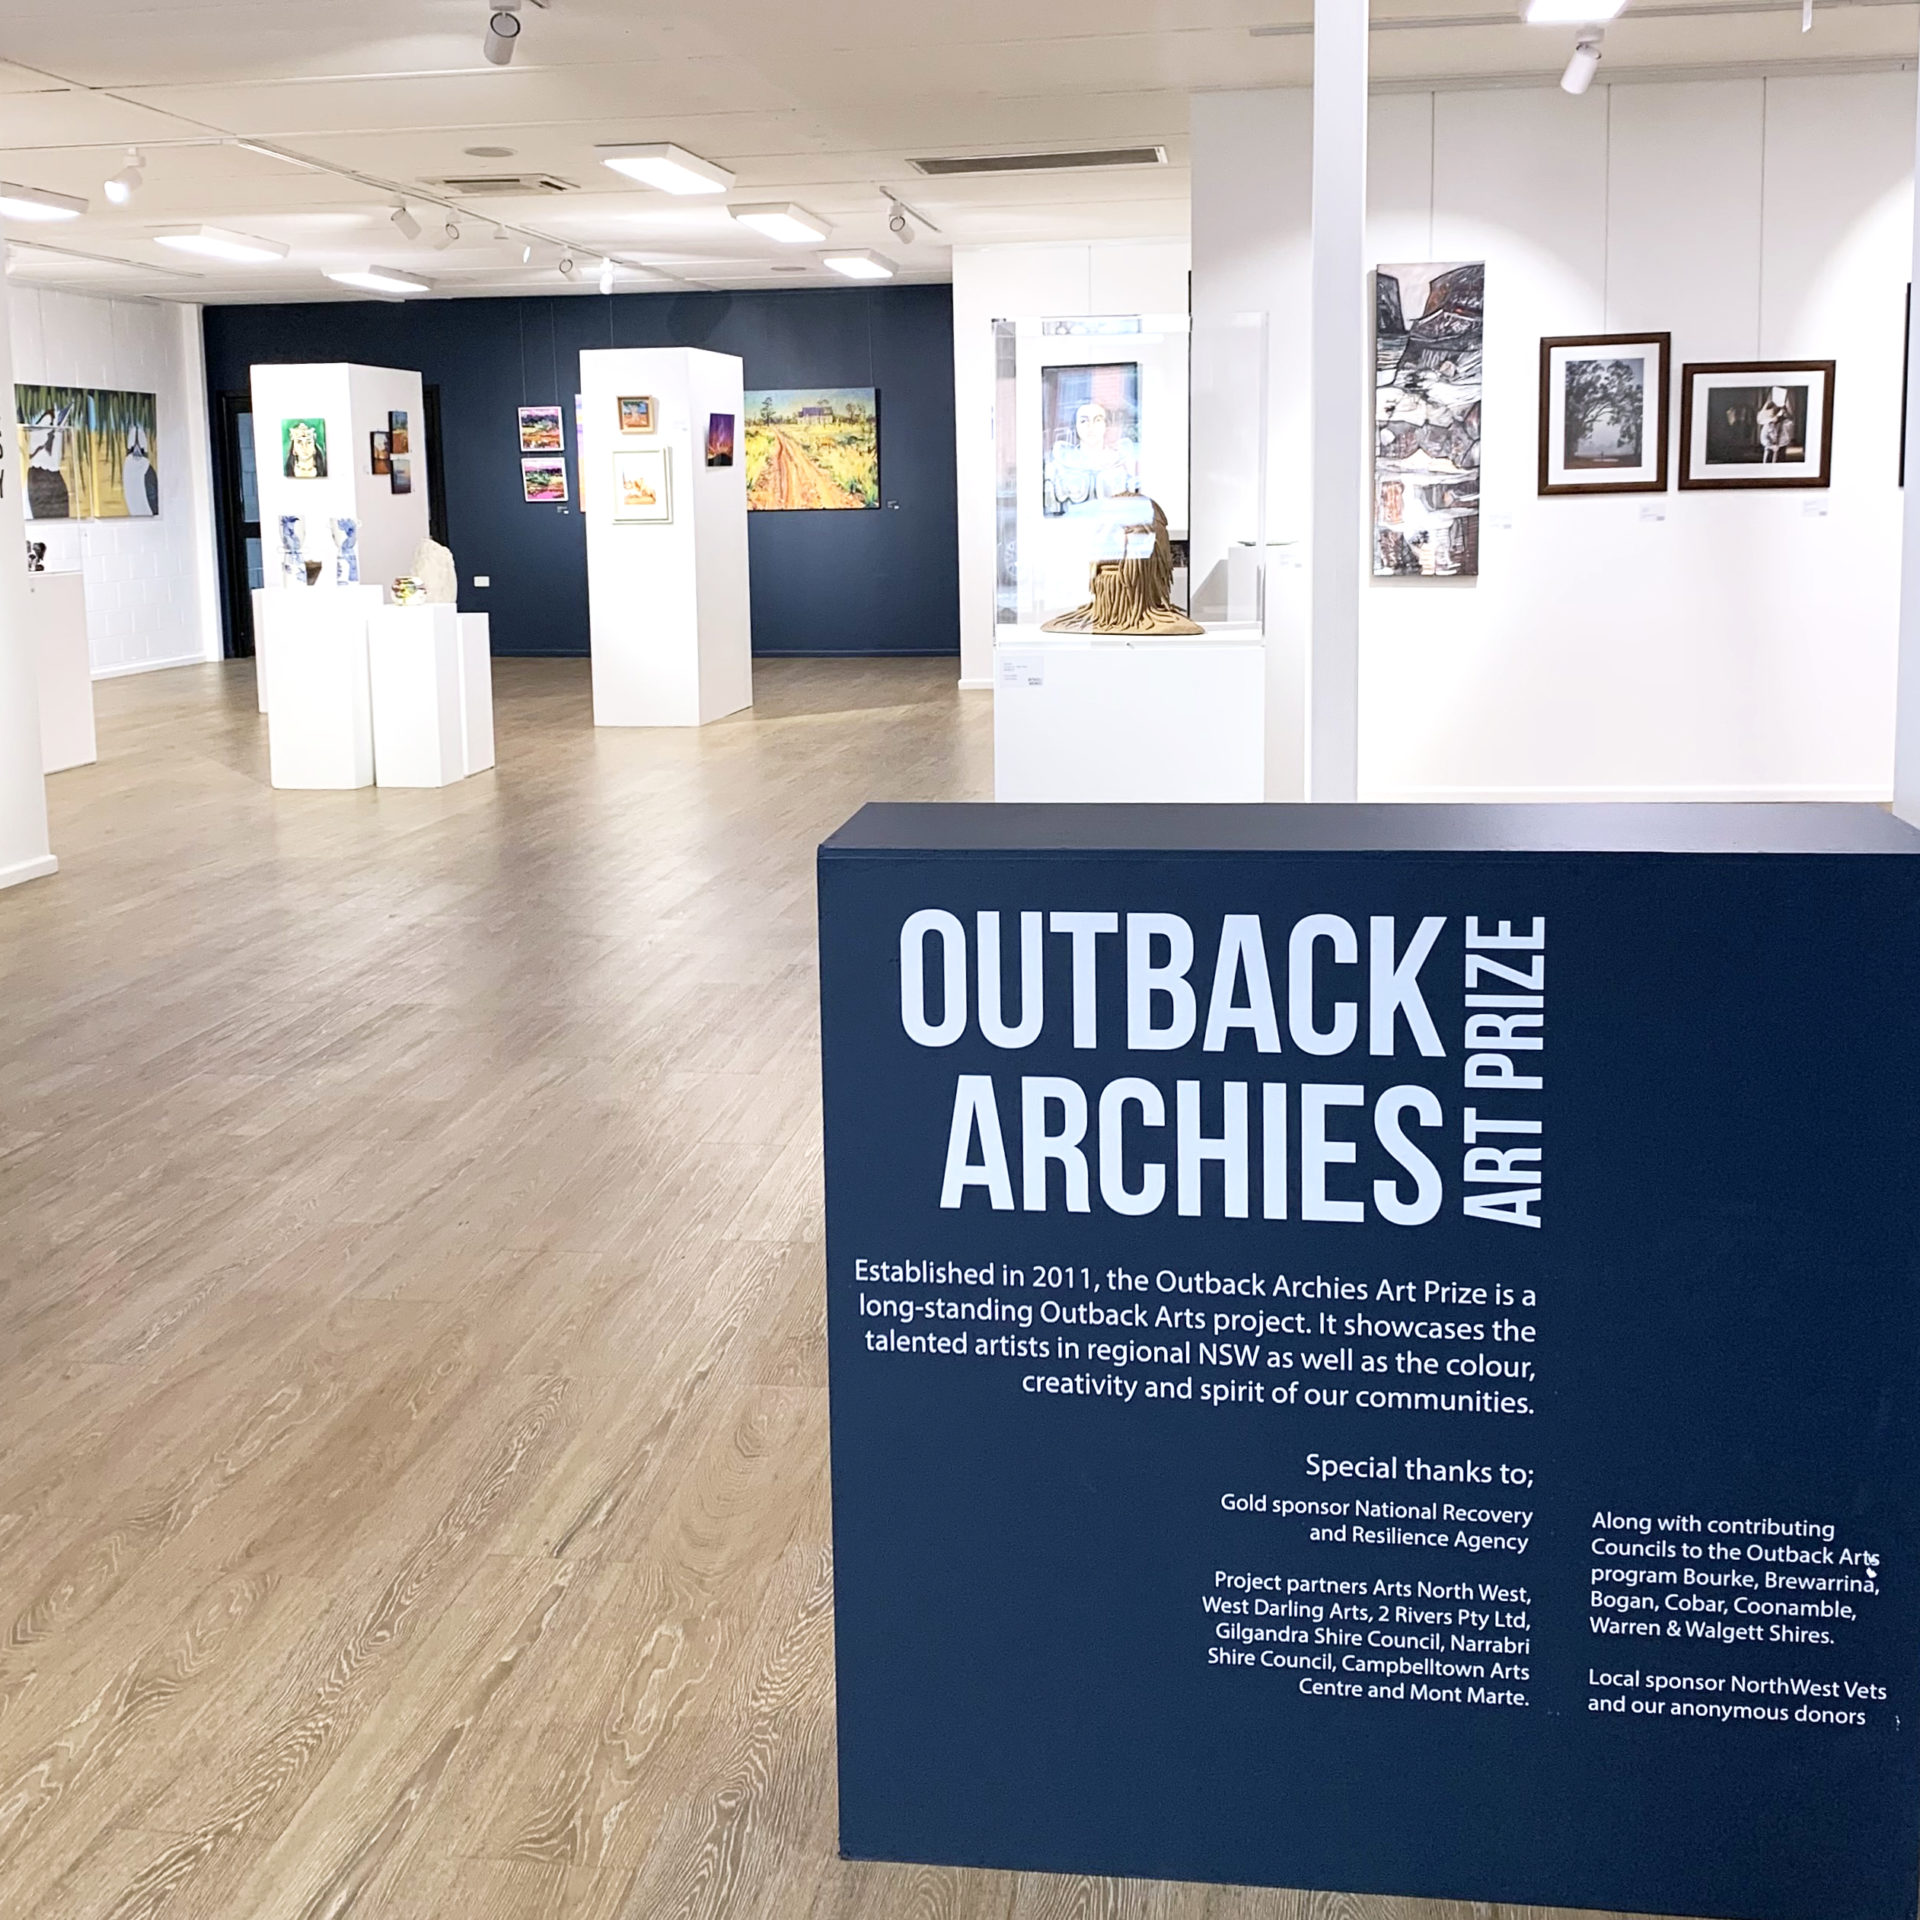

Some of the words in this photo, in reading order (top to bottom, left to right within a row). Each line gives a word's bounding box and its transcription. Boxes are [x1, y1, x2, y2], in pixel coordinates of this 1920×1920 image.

[899, 908, 1448, 1058] OUTBACK
[1463, 914, 1546, 1090] PRIZE
[939, 1074, 1443, 1226] ARCHIES
[1463, 1106, 1543, 1229] ART
[855, 1258, 995, 1286] Established
[1002, 1263, 1025, 1287] in
[1032, 1265, 1100, 1293] 2011,
[1106, 1266, 1149, 1292] the
[1155, 1269, 1267, 1297] Outback
[1272, 1274, 1369, 1301] Archies
[1375, 1278, 1417, 1303] Art
[1424, 1280, 1488, 1305] Prize
[1495, 1282, 1515, 1306] is
[1521, 1289, 1536, 1307] a
[859, 1292, 1033, 1328] long-standing
[1040, 1300, 1149, 1327] Outback
[1154, 1305, 1206, 1330] Arts
[1213, 1309, 1312, 1338] project.
[1319, 1311, 1337, 1335] It
[1344, 1312, 1485, 1341] showcases
[1491, 1318, 1537, 1343] the
[864, 1328, 968, 1355] talented
[974, 1334, 1050, 1358] artists
[1057, 1336, 1080, 1360] in
[1087, 1339, 1191, 1367] regional
[1199, 1342, 1261, 1367] NSW
[1266, 1351, 1294, 1369] as
[1300, 1347, 1353, 1371] well
[1360, 1355, 1388, 1373] as
[1394, 1350, 1439, 1375] the
[1446, 1352, 1536, 1382] colour,
[1022, 1372, 1139, 1403] creativity
[1144, 1376, 1193, 1400] and
[1200, 1379, 1265, 1407] spirit
[1271, 1380, 1300, 1404] of
[1304, 1388, 1350, 1407] our
[1355, 1389, 1535, 1415] communities.
[1305, 1453, 1397, 1482] Special
[1404, 1457, 1493, 1484] thanks
[1499, 1463, 1534, 1489] to;
[1220, 1493, 1267, 1512] Gold
[1272, 1499, 1351, 1518] sponsor
[1355, 1499, 1437, 1520] National
[1442, 1503, 1534, 1529] Recovery
[1591, 1511, 1652, 1535] Along
[1657, 1514, 1702, 1533] with
[1707, 1517, 1835, 1542] contributing
[1309, 1524, 1347, 1542] and
[1352, 1525, 1449, 1547] Resilience
[1453, 1530, 1529, 1555] Agency
[1591, 1537, 1677, 1558] Councils
[1681, 1542, 1703, 1559] to
[1707, 1541, 1742, 1561] the
[1746, 1544, 1834, 1565] Outback
[1838, 1547, 1881, 1567] Arts
[1215, 1570, 1282, 1594] Project
[1287, 1577, 1368, 1596] partners
[1372, 1578, 1412, 1598] Arts
[1417, 1580, 1474, 1601] North
[1478, 1583, 1532, 1606] West,
[1591, 1568, 1678, 1587] program
[1683, 1567, 1759, 1591] Bourke,
[1765, 1571, 1880, 1596] Brewarrina,
[1201, 1595, 1250, 1615] West
[1254, 1598, 1324, 1623] Darling
[1329, 1602, 1374, 1624] Arts,
[1378, 1605, 1390, 1622] 2
[1395, 1605, 1453, 1625] Rivers
[1458, 1608, 1490, 1631] Pty
[1494, 1610, 1531, 1632] Ltd,
[1590, 1590, 1660, 1613] Bogan,
[1664, 1593, 1729, 1616] Cobar,
[1733, 1596, 1857, 1622] Coonamble,
[1215, 1622, 1309, 1645] Gilgandra
[1314, 1626, 1363, 1647] Shire
[1367, 1630, 1445, 1653] Council,
[1450, 1634, 1530, 1655] Narrabri
[1589, 1616, 1661, 1636] Warren
[1666, 1619, 1682, 1637] &
[1684, 1620, 1764, 1644] Walgett
[1769, 1624, 1835, 1645] Shires.
[1207, 1646, 1256, 1666] Shire
[1260, 1650, 1337, 1673] Council,
[1341, 1654, 1485, 1678] Campbelltown
[1489, 1662, 1530, 1681] Arts
[1298, 1677, 1363, 1698] Centre
[1367, 1681, 1405, 1700] and
[1410, 1683, 1463, 1703] Mont
[1467, 1686, 1530, 1707] Marte.
[1589, 1668, 1640, 1688] Local
[1645, 1675, 1726, 1693] sponsor
[1731, 1675, 1840, 1698] NorthWest
[1843, 1680, 1887, 1700] Vets
[1587, 1694, 1626, 1713] and
[1630, 1700, 1666, 1715] our
[1670, 1702, 1789, 1722] anonymous
[1794, 1704, 1866, 1726] donors
